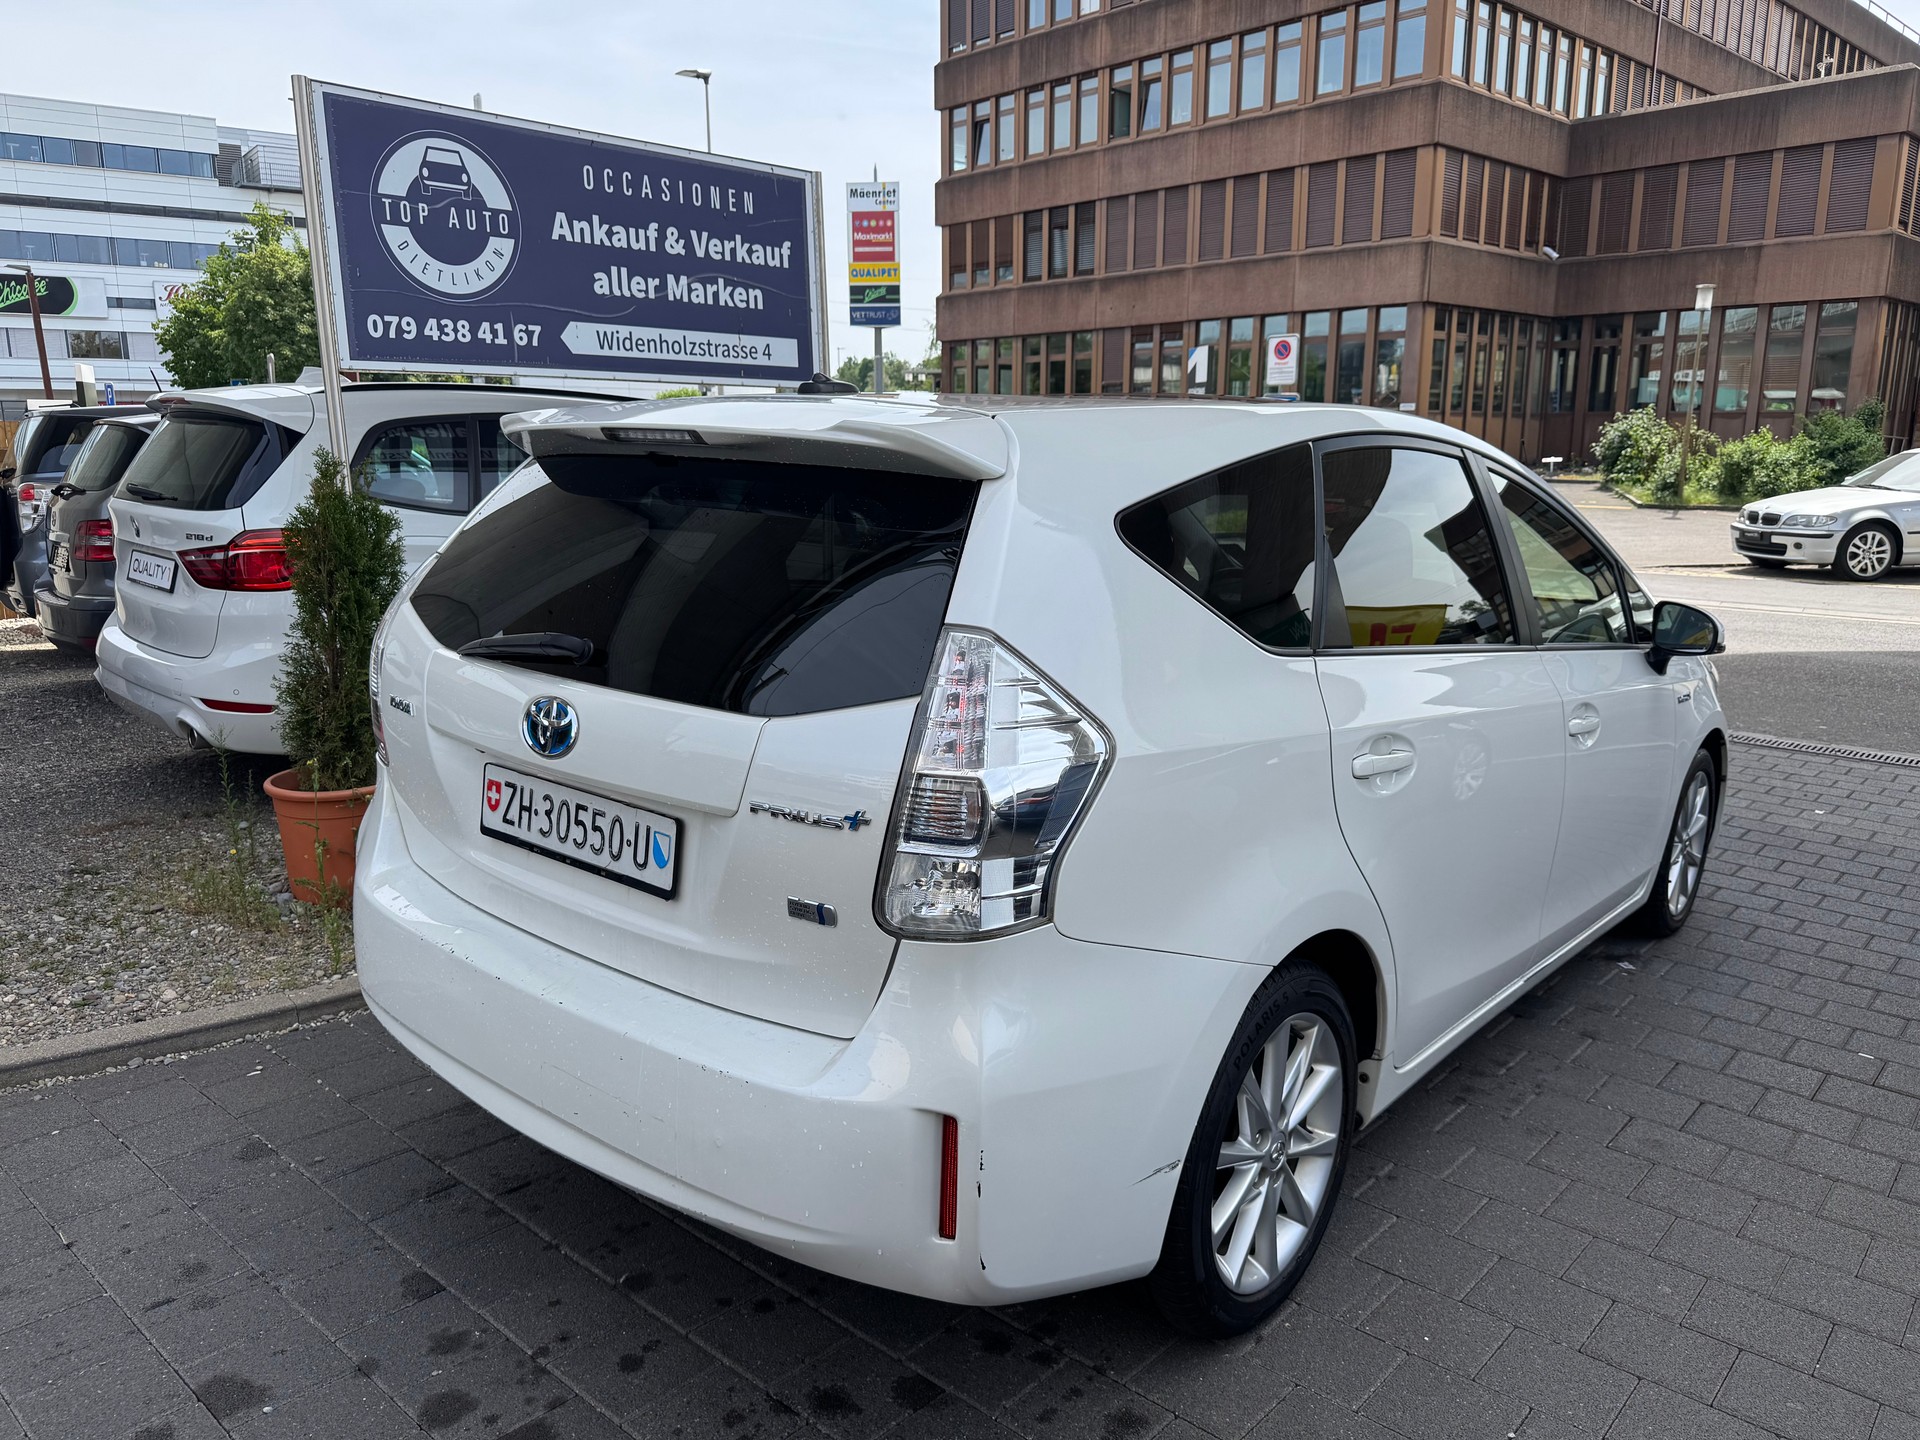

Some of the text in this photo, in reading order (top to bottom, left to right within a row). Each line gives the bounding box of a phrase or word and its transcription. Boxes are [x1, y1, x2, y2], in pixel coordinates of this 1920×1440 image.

[582, 164, 754, 215] OCCASIONEN
[381, 198, 509, 235] TOP AUTO
[551, 211, 791, 269] Ankauf & Verkauf
[397, 239, 505, 286] DIETLIKON
[850, 267, 898, 278] QUALIPET
[593, 265, 764, 311] aller Marken
[366, 314, 542, 347] 079 438 41 67
[596, 329, 773, 361] Widenholzstrasse 4
[132, 558, 167, 581] QUALITY
[1232, 999, 1281, 1072] POLARIS
